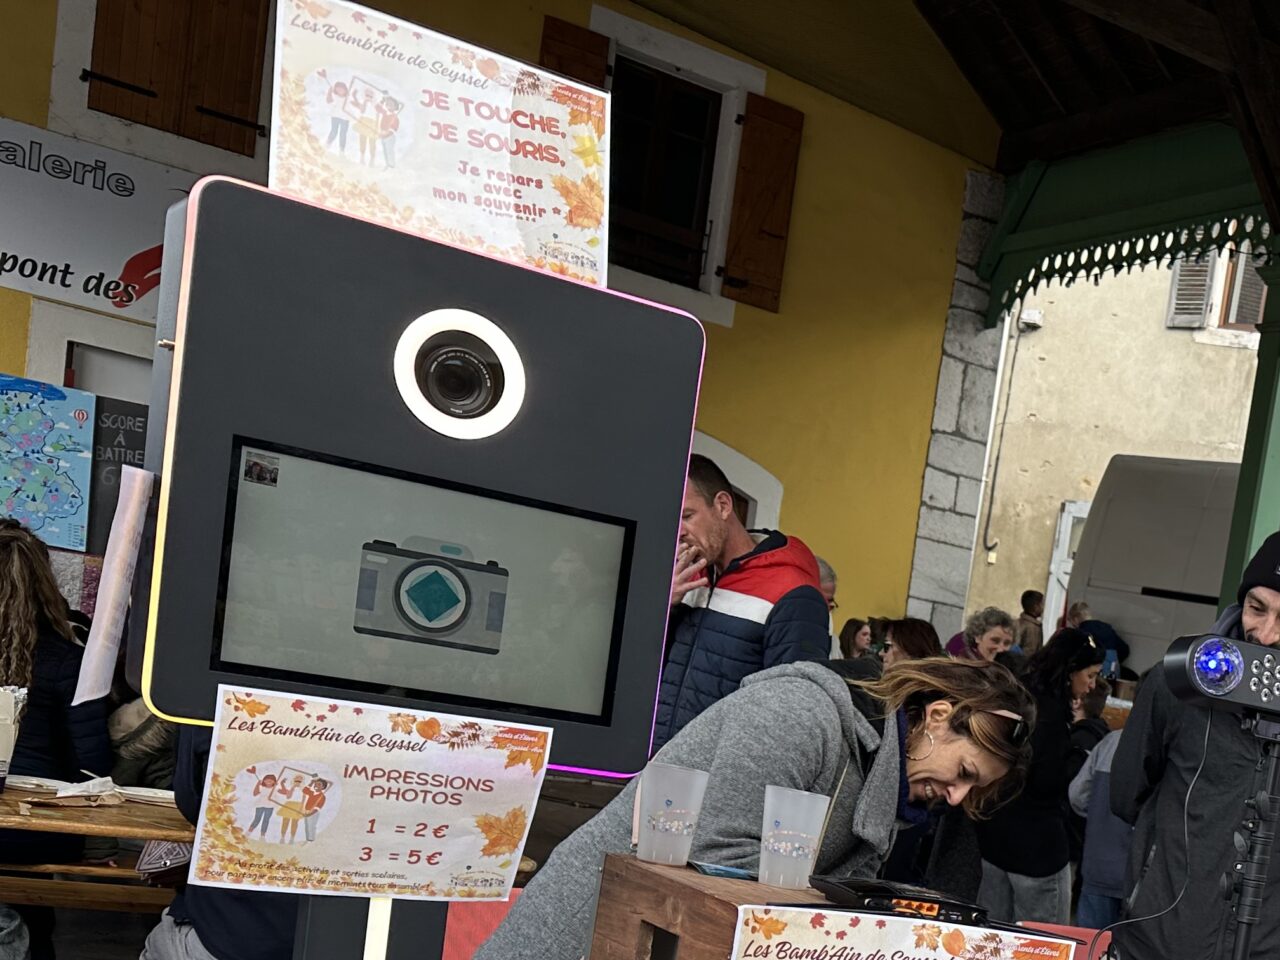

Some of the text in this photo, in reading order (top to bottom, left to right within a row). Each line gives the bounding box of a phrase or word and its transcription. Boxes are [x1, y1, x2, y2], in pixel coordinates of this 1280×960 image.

[290, 13, 489, 90] Les Bamb'Ain de Seyssel
[420, 89, 450, 111] JE
[428, 121, 458, 143] JE
[457, 160, 543, 190] Je repars
[483, 182, 522, 199] avec
[433, 187, 467, 203] mon
[474, 194, 546, 218] souvenir
[82, 272, 138, 303] des
[100, 413, 145, 432] SCORE
[96, 446, 144, 463] BATTRE
[227, 716, 255, 733] Les
[259, 719, 343, 743] Bamb'Ain
[343, 730, 367, 746] de
[367, 734, 427, 753] Seyssel
[370, 785, 463, 805] PHOTOS
[366, 818, 376, 834] 1
[359, 846, 373, 862] 3
[205, 869, 225, 878] pour
[250, 862, 274, 871] profit
[342, 870, 369, 878] sorties
[743, 940, 773, 958] Les
